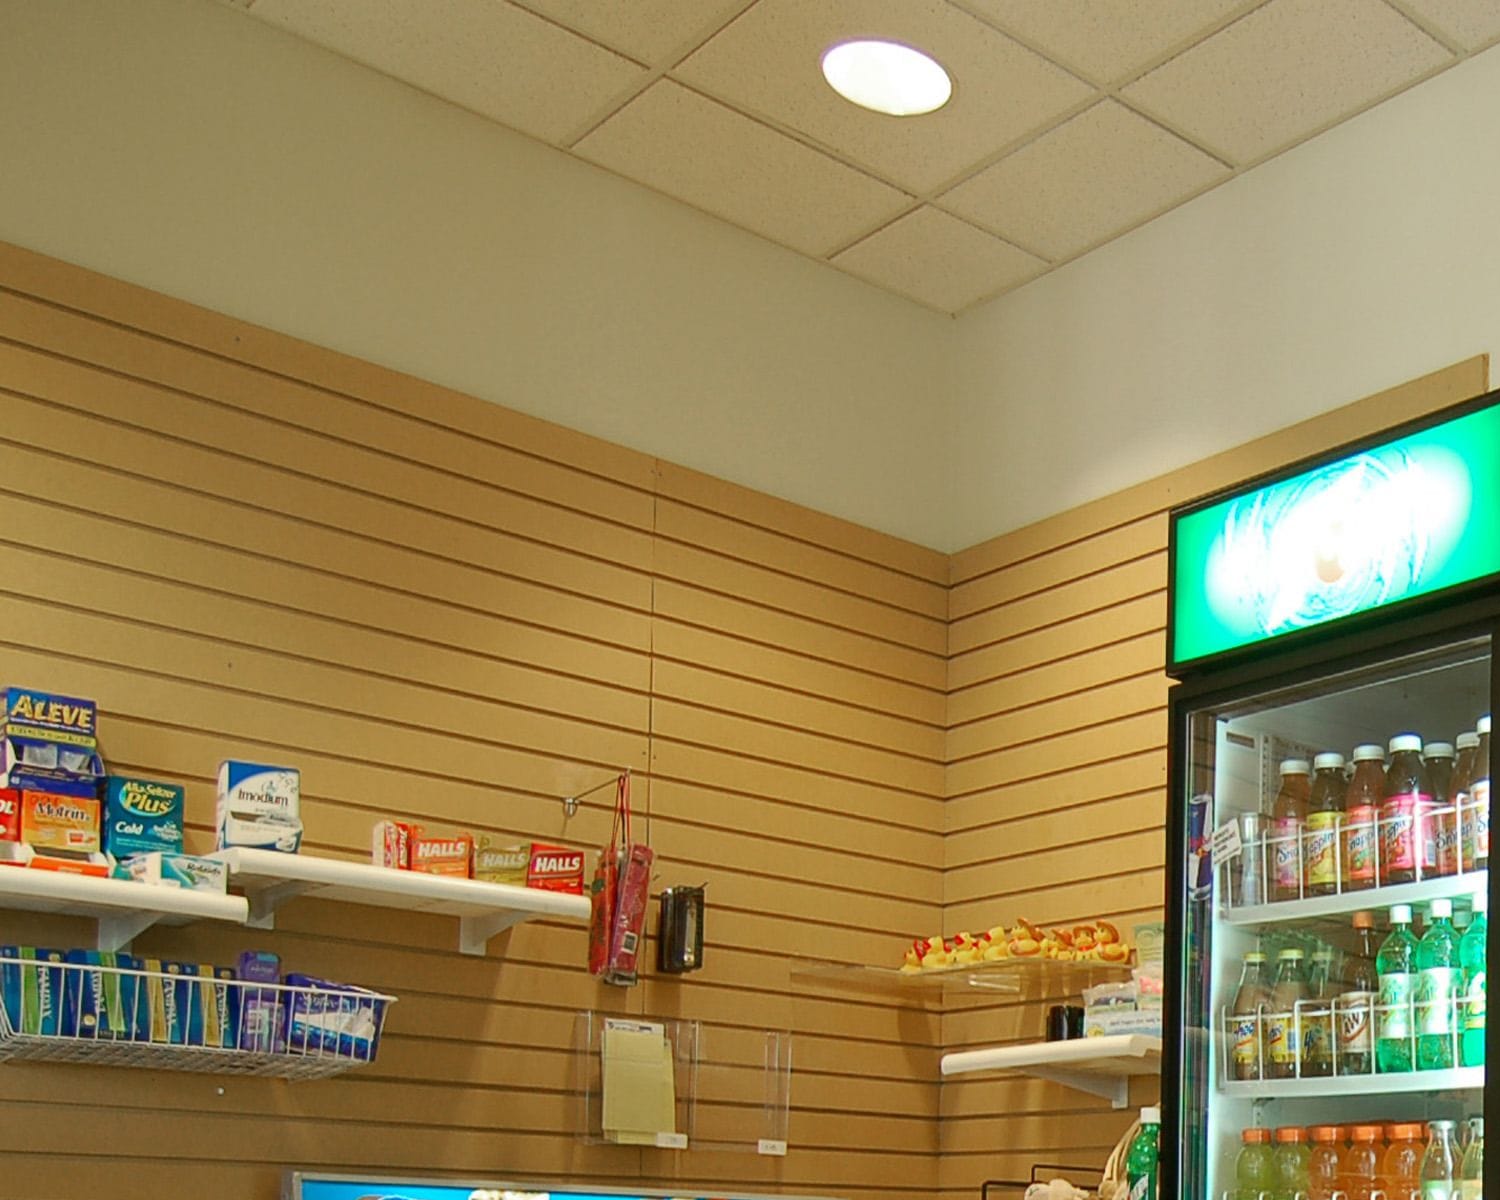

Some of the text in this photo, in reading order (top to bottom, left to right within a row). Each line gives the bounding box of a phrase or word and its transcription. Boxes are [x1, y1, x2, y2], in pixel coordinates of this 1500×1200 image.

[11, 693, 95, 729] ALEVE
[124, 792, 172, 814] Plus
[115, 821, 144, 836] Cold
[417, 841, 466, 858] HALLS
[482, 851, 526, 867] HALLS
[534, 856, 581, 872] HALLS
